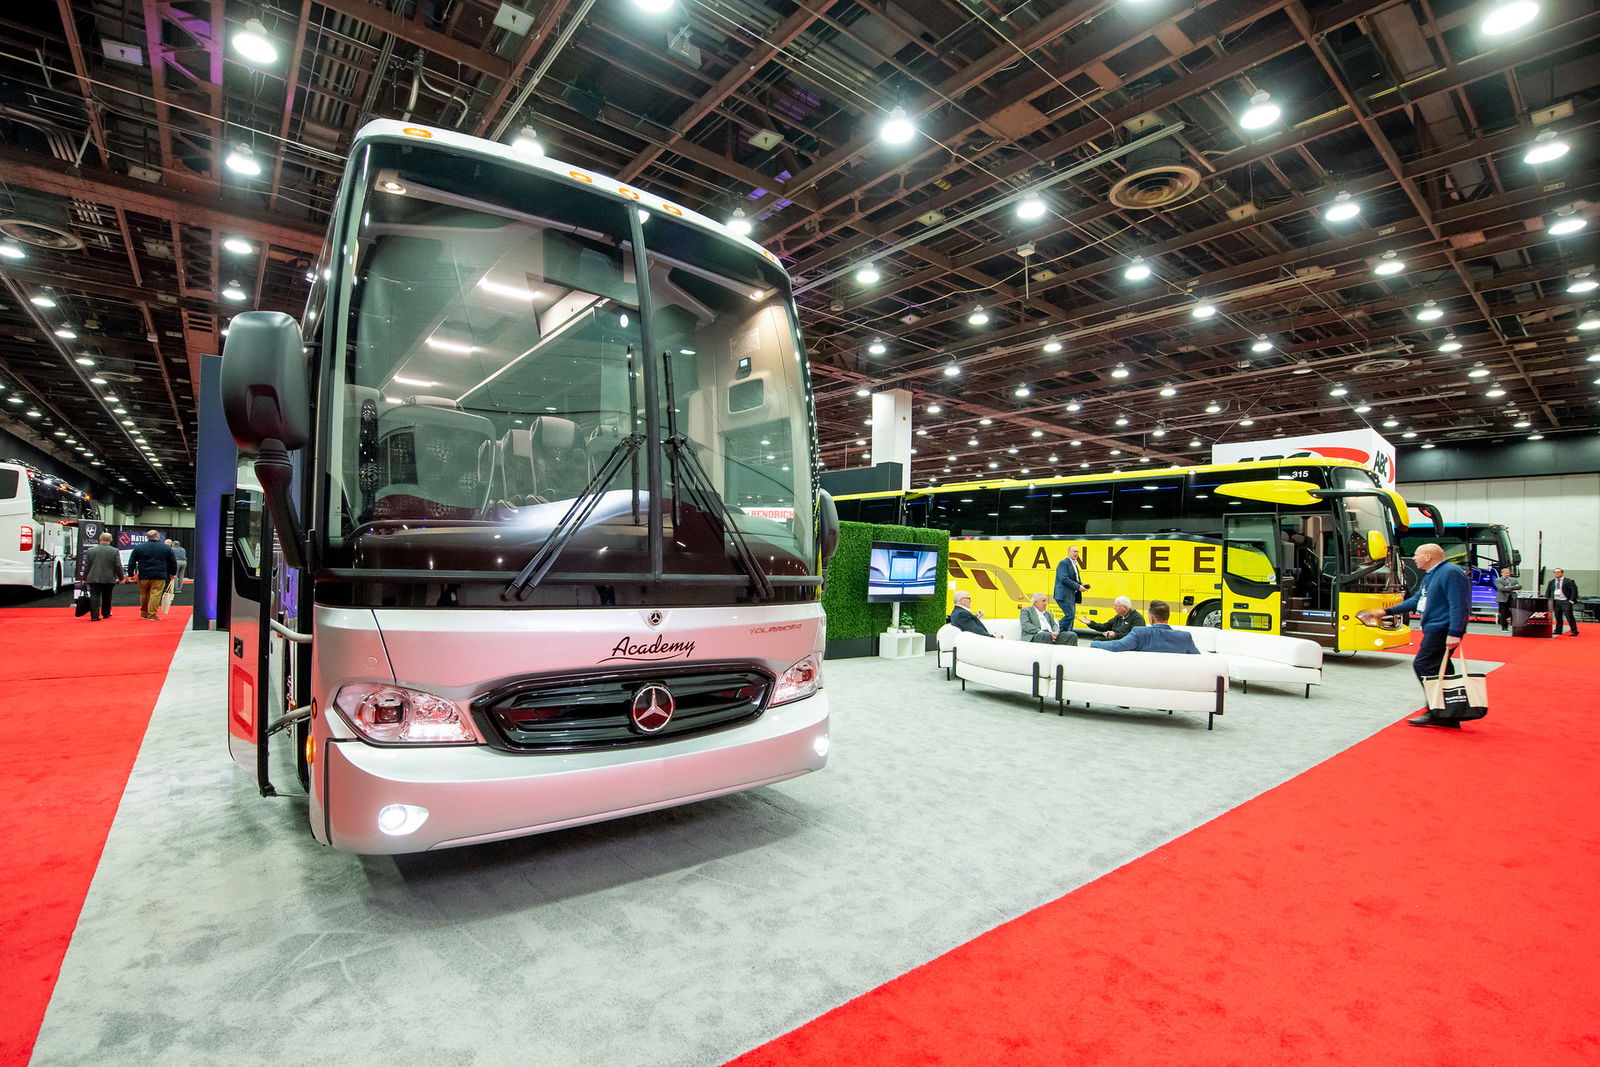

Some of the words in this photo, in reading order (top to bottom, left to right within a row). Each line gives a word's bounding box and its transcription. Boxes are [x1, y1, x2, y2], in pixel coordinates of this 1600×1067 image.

[1373, 450, 1388, 478] ABC
[1003, 546, 1215, 573] YANKEE
[611, 634, 695, 658] Academy
